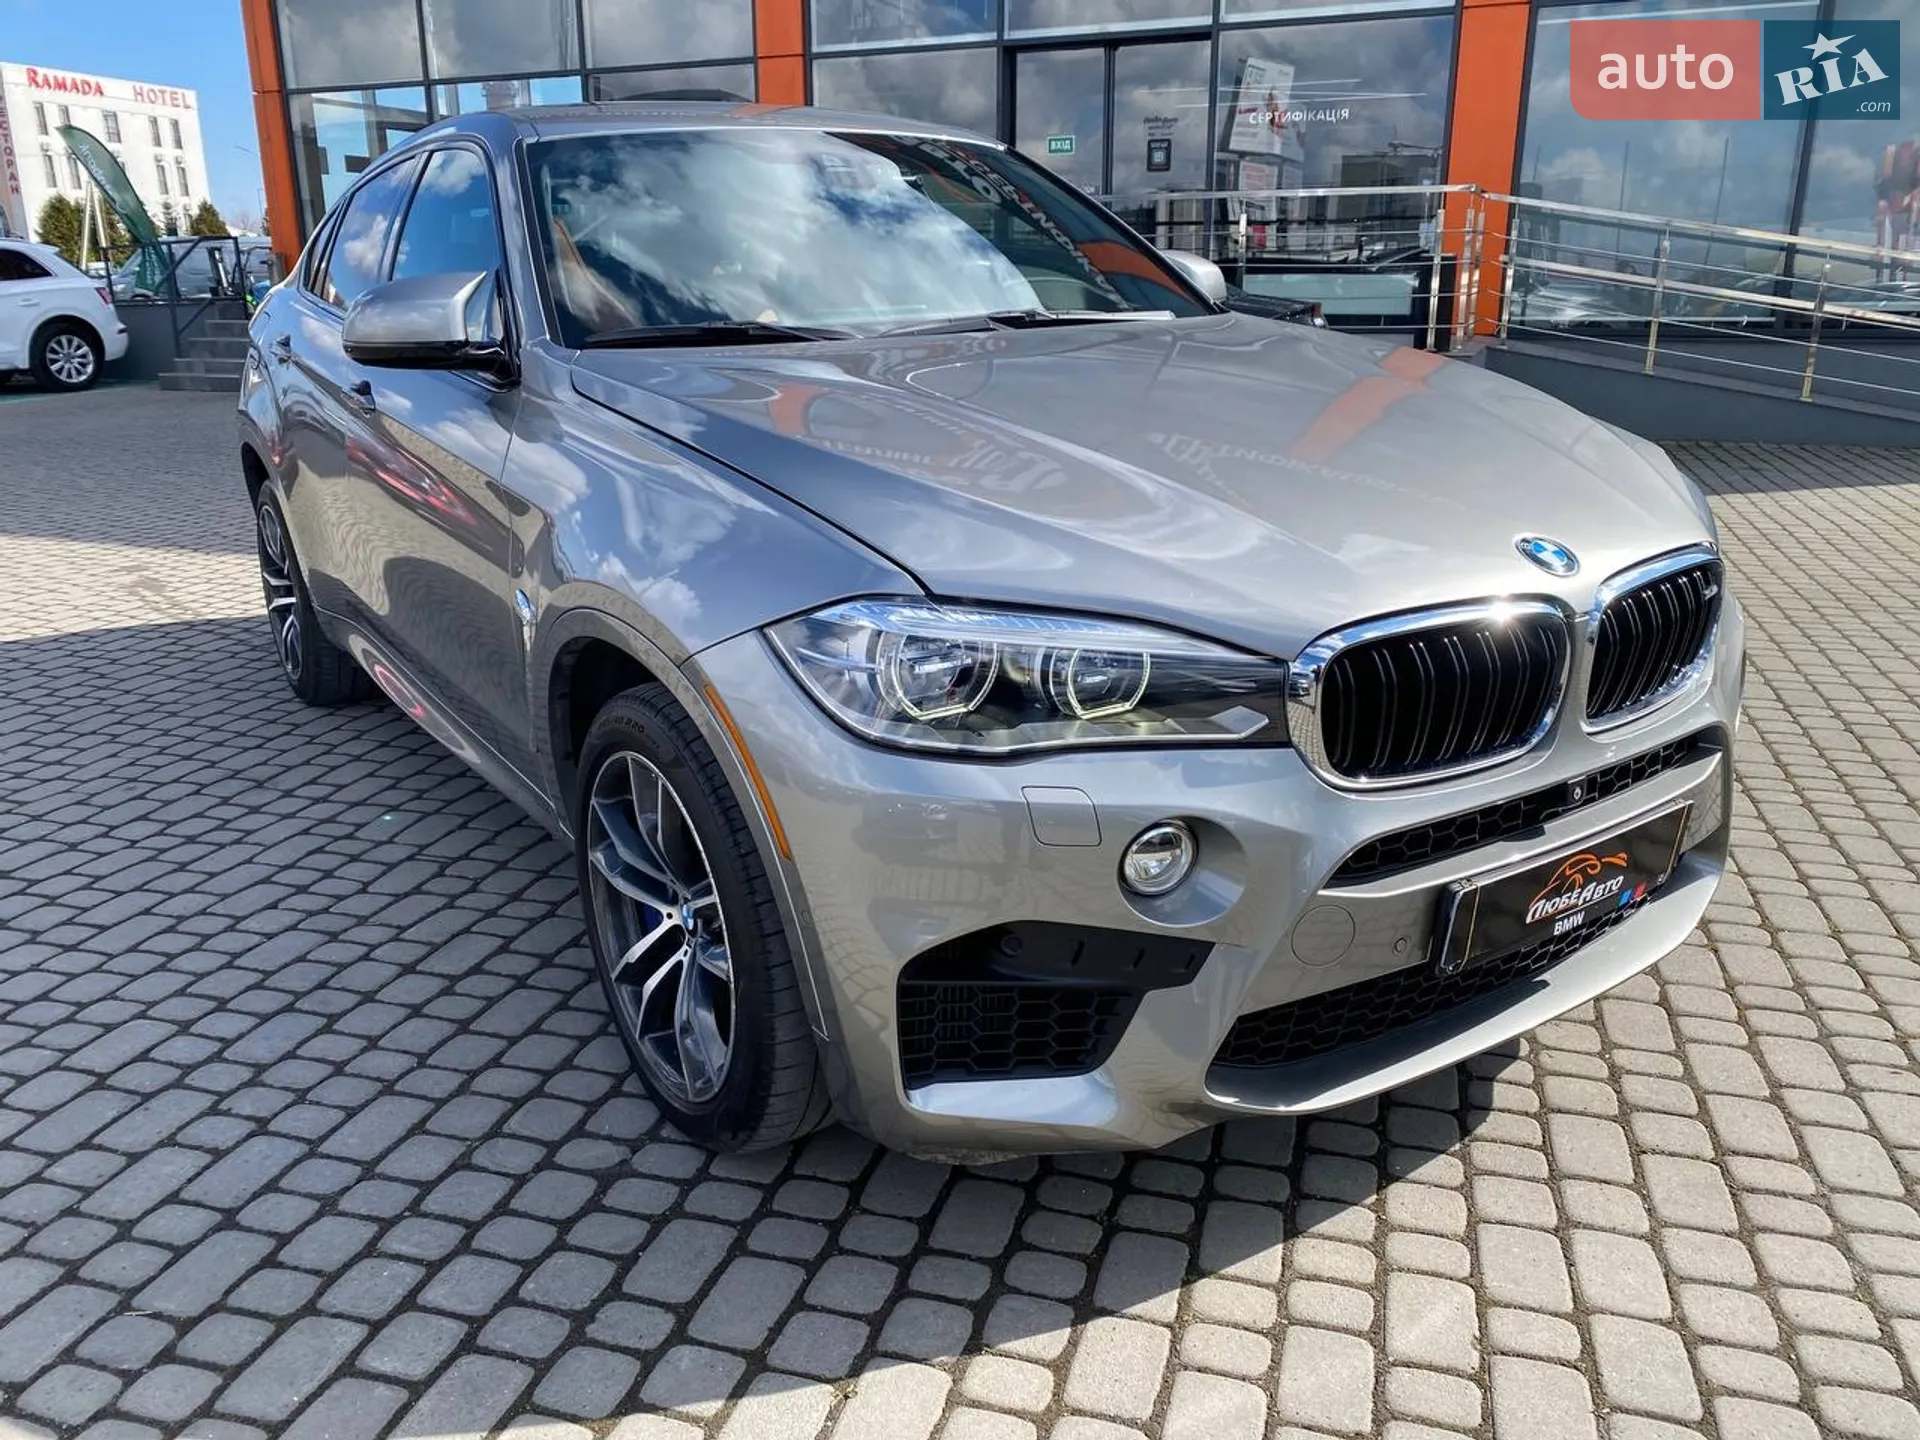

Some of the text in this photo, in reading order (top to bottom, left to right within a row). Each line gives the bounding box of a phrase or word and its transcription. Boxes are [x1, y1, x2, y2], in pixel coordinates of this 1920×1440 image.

[133, 84, 193, 110] HOTEL
[1249, 107, 1351, 124] СЕРТИФІКАЦІЯ
[1050, 139, 1071, 151] ВХІД
[1554, 910, 1586, 935] BMW
